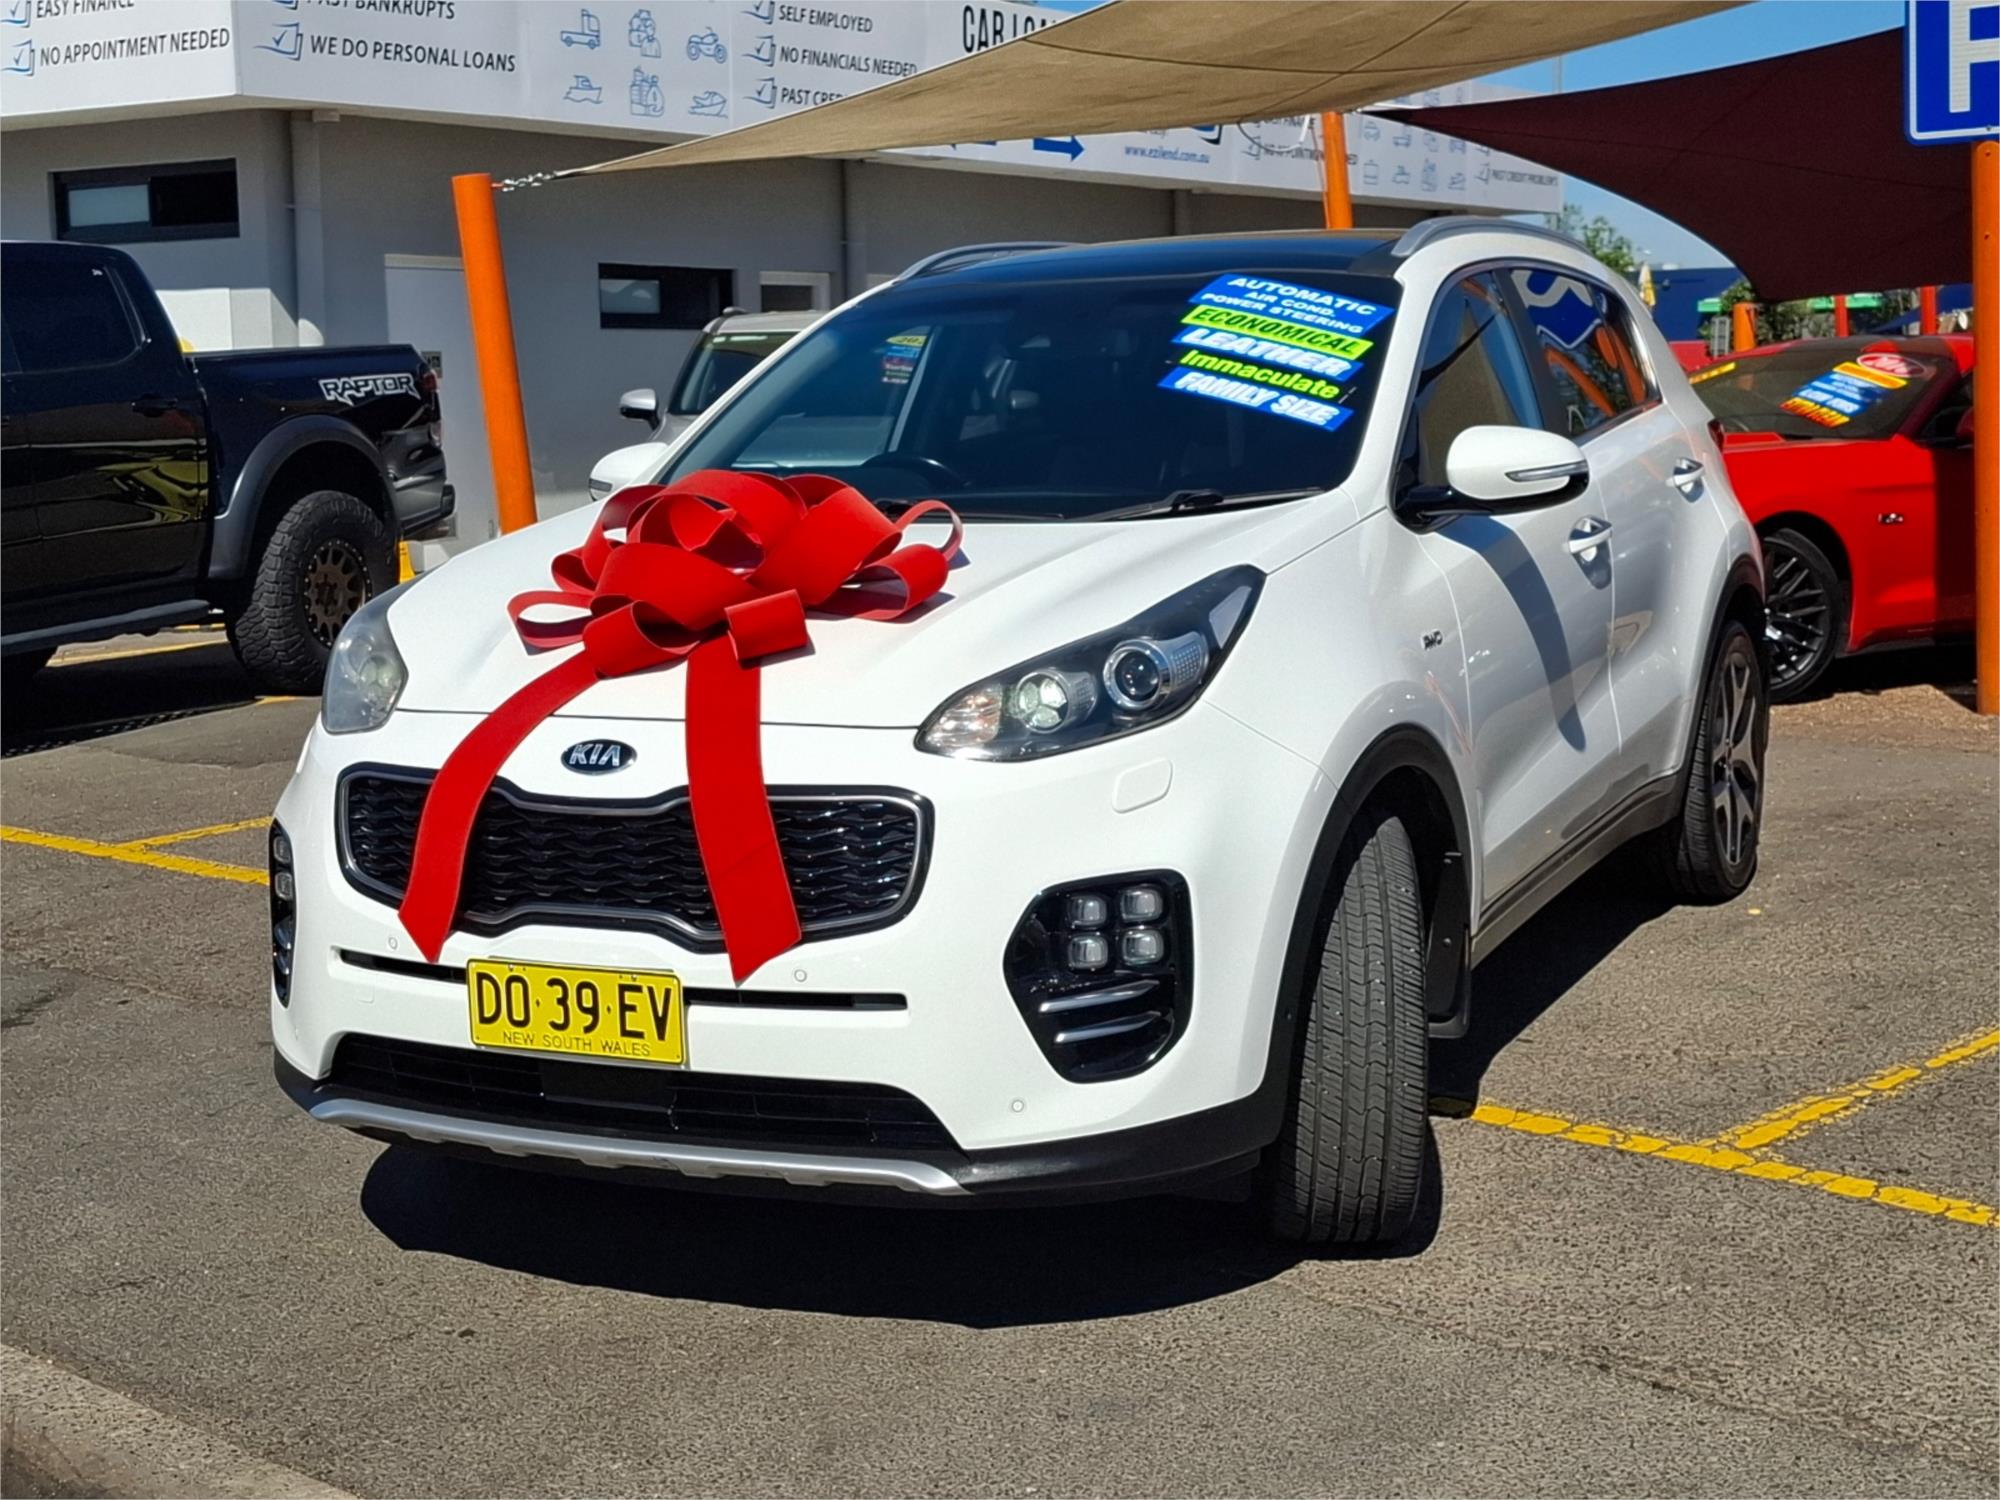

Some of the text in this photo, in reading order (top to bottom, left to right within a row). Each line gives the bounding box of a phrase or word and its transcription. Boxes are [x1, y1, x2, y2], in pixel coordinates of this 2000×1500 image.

[36, 0, 70, 18] EASY
[779, 5, 873, 33] SELF EMPLOYED
[40, 28, 230, 67] NO APPOINTMENT NEEDED
[963, 5, 1004, 53] CAR
[311, 35, 516, 73] WE DO PERSONAL LOANS
[780, 46, 918, 77] NO FINANCIALS NEEDED
[781, 87, 810, 106] PAST
[1201, 293, 1363, 334] POWER STEERING
[1227, 277, 1376, 316] AUTOMATIC
[1244, 292, 1336, 317] AIR COND.
[1192, 307, 1358, 355] ECONOMICAL
[1180, 328, 1352, 376] LEATHER
[319, 373, 421, 407] RAPTOR
[1179, 349, 1340, 400] Immaculate
[1174, 371, 1340, 426] FAMILY SIZE
[569, 743, 621, 767] KIA
[503, 1031, 650, 1057] NEW SOUTH WALES
